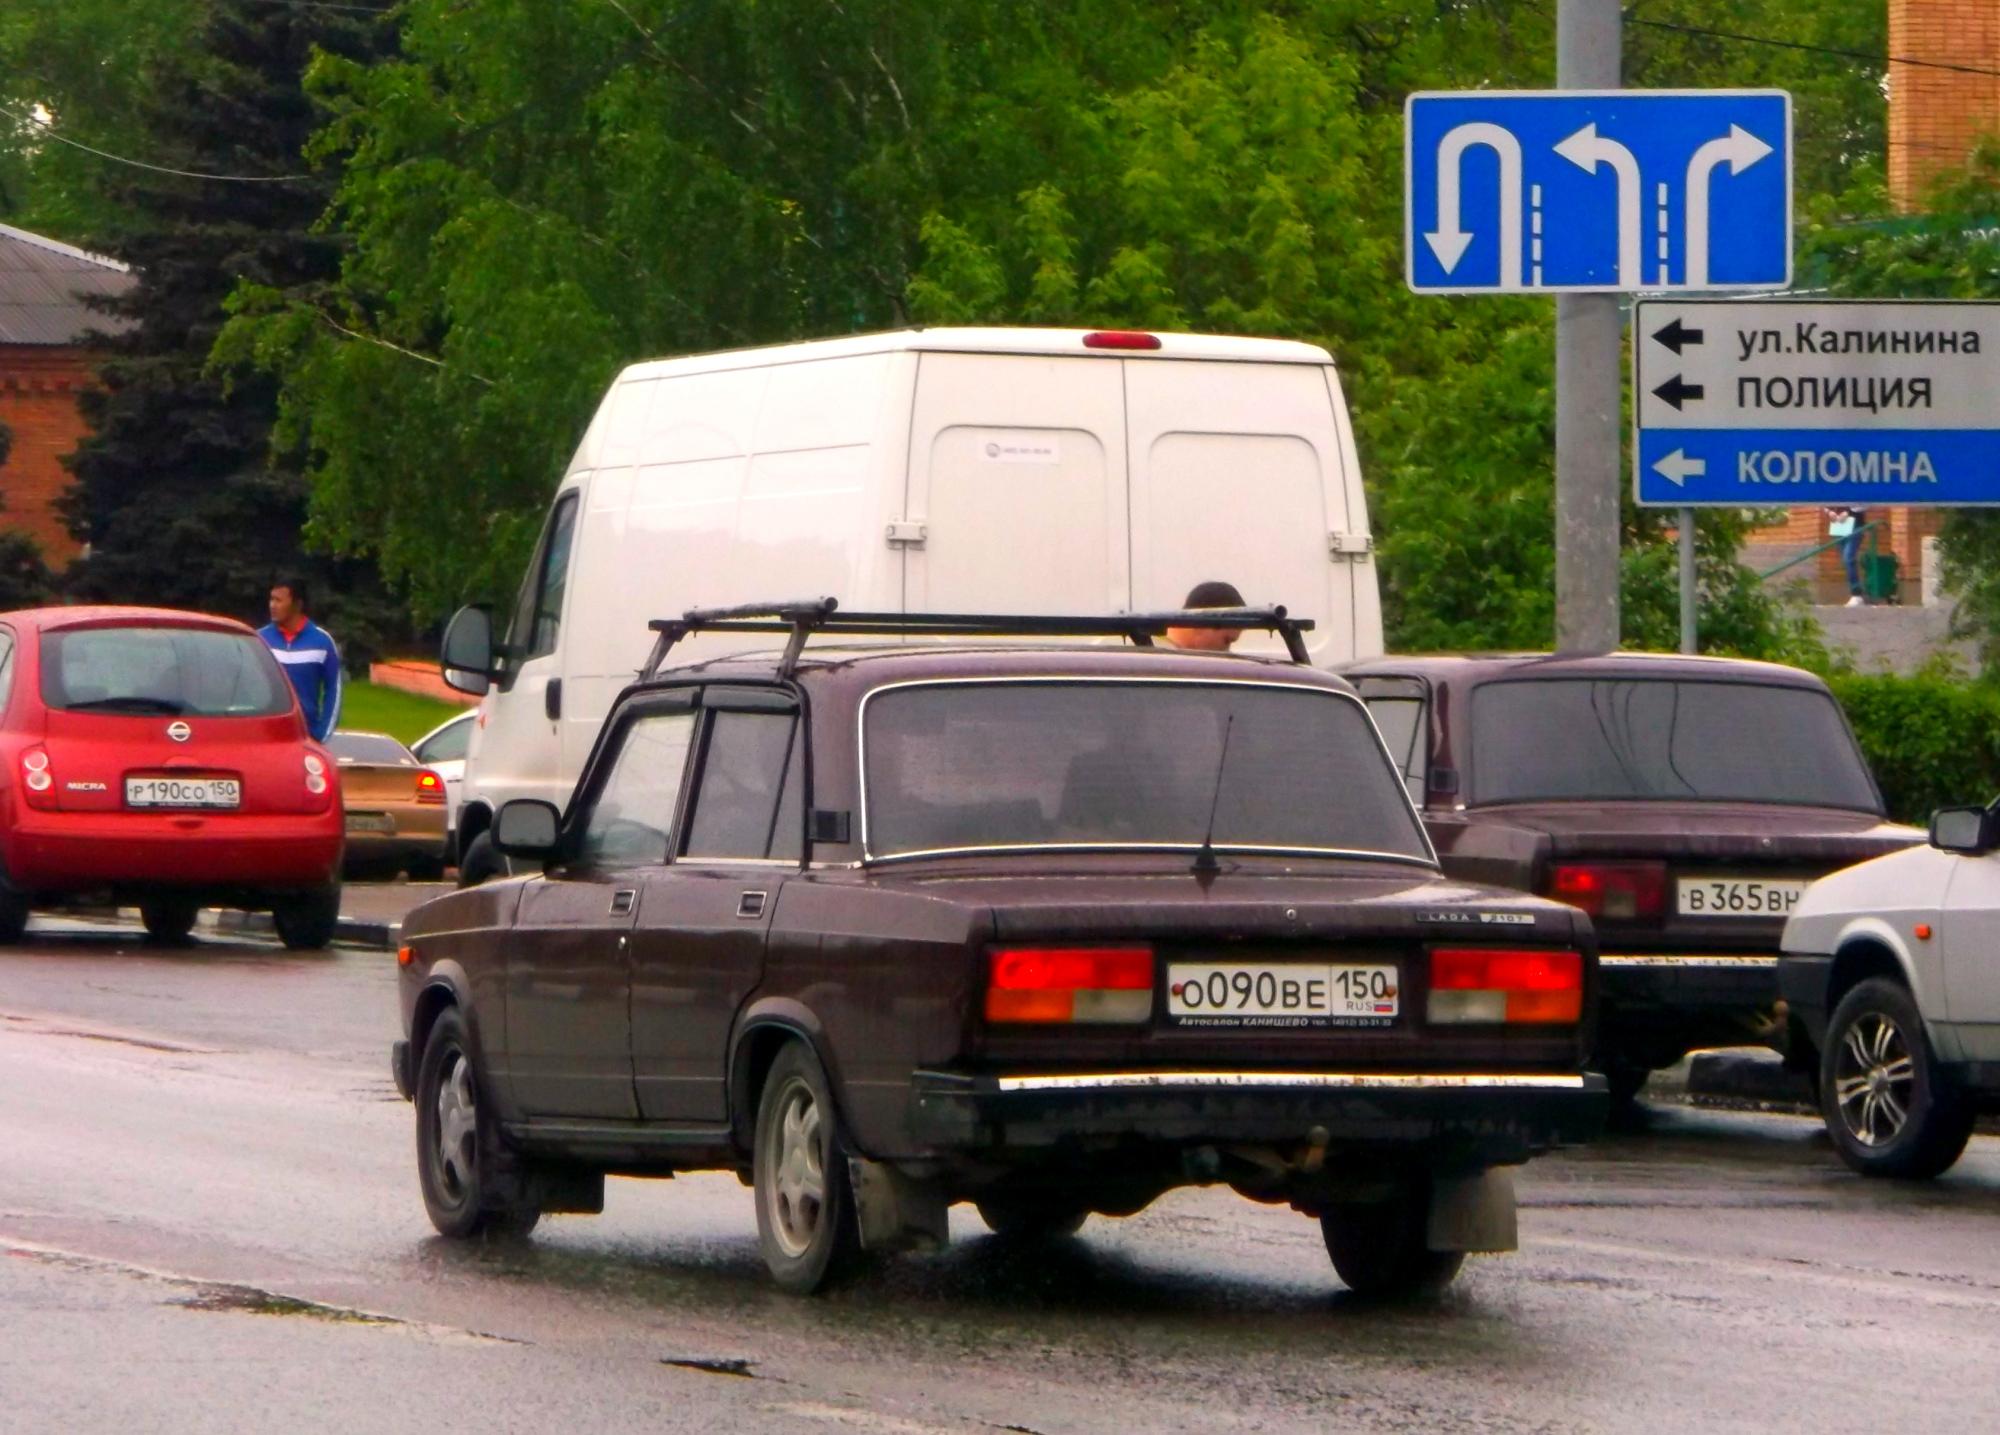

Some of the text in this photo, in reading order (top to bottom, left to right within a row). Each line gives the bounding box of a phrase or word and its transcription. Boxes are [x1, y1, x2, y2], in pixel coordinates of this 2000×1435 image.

[1737, 322, 1981, 361] ул.Калинина
[1737, 376, 1932, 414] ПОЛИЦИЯ
[1737, 450, 1938, 484] КОЛОМНА
[66, 782, 107, 791] MICRA
[208, 781, 235, 796] 150
[1428, 913, 1470, 921] LADA
[1335, 970, 1388, 999] 150
[1346, 1001, 1373, 1011] RUS
[1179, 1017, 1240, 1026] Автосалон
